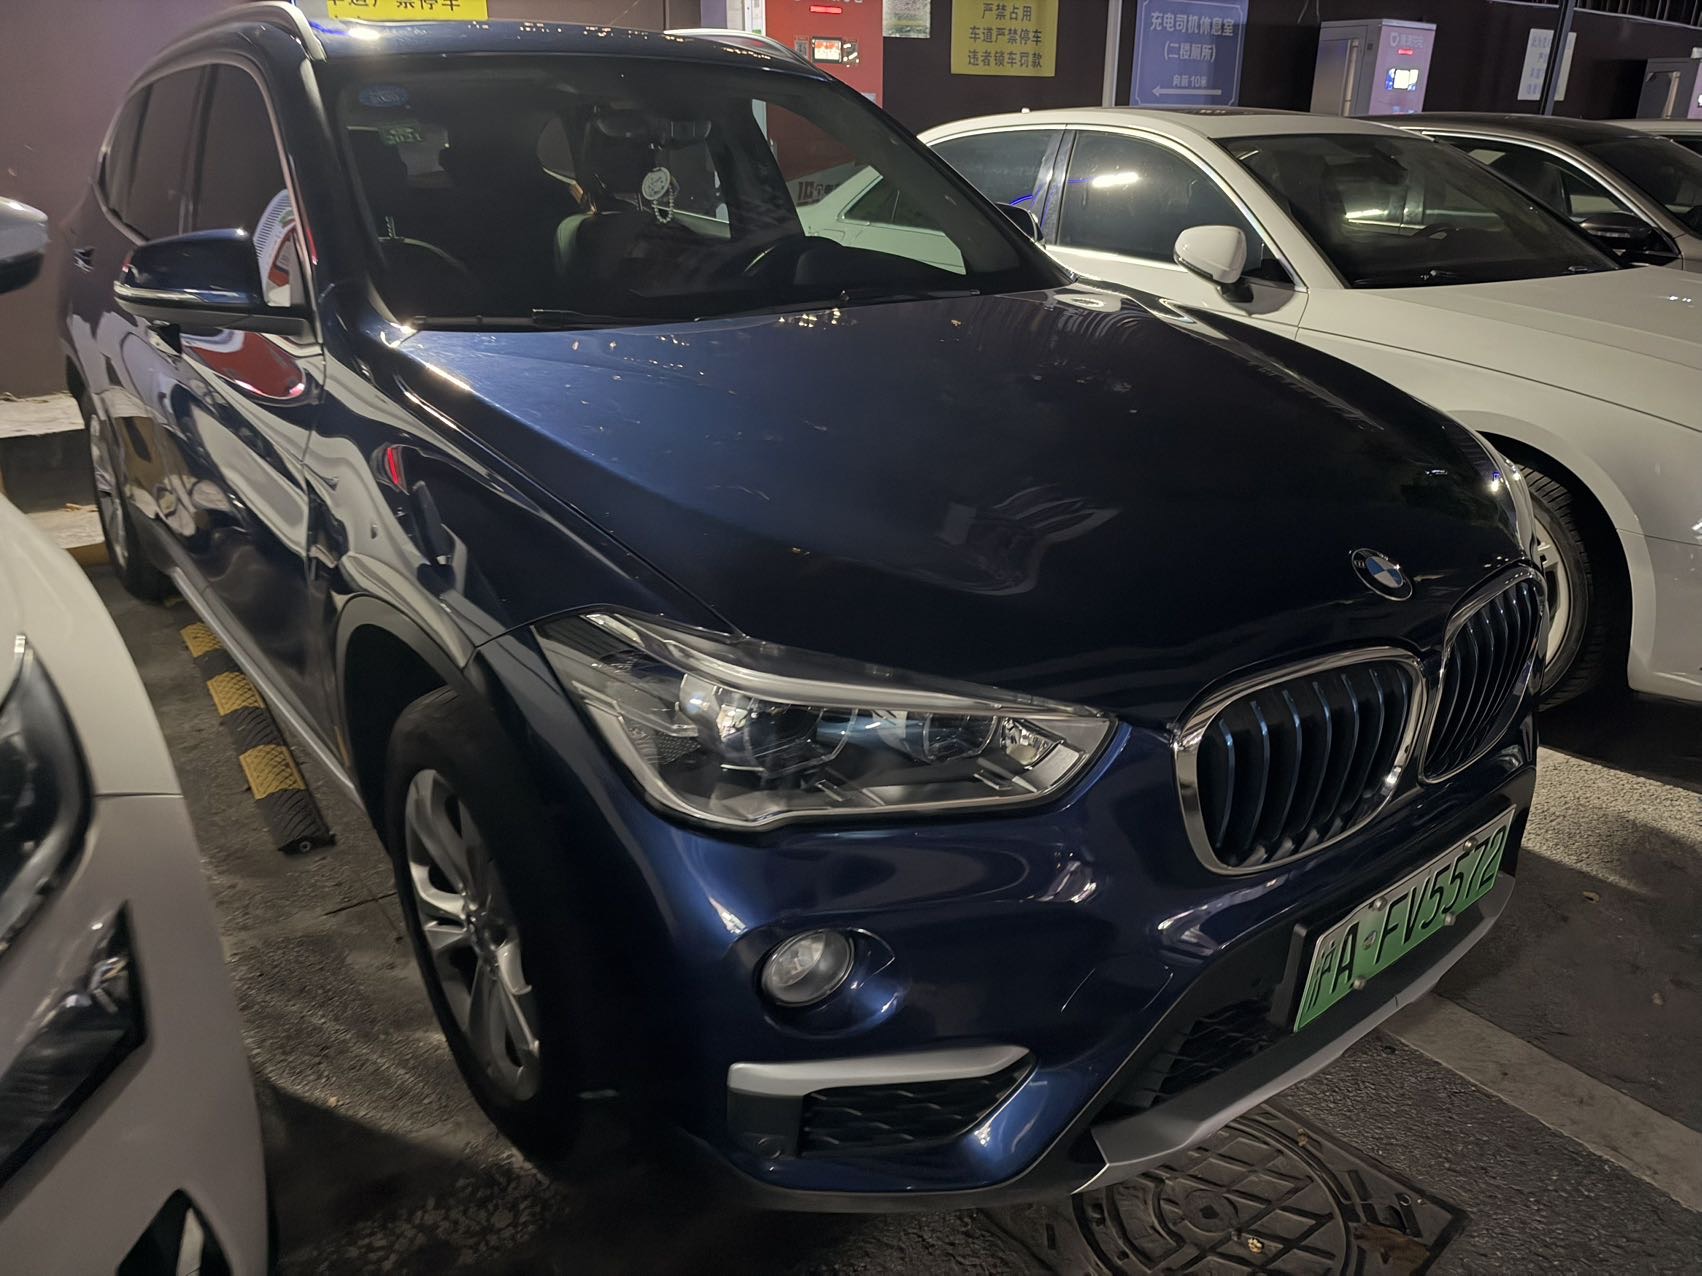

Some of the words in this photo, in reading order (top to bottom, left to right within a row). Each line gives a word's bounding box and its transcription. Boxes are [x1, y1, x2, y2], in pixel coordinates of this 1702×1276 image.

[982, 2, 1032, 21] 严禁占用
[1150, 12, 1234, 36] 充电司机休息室
[969, 25, 1042, 46] 车道严禁停车
[968, 49, 1042, 68] 违者锁车罚款
